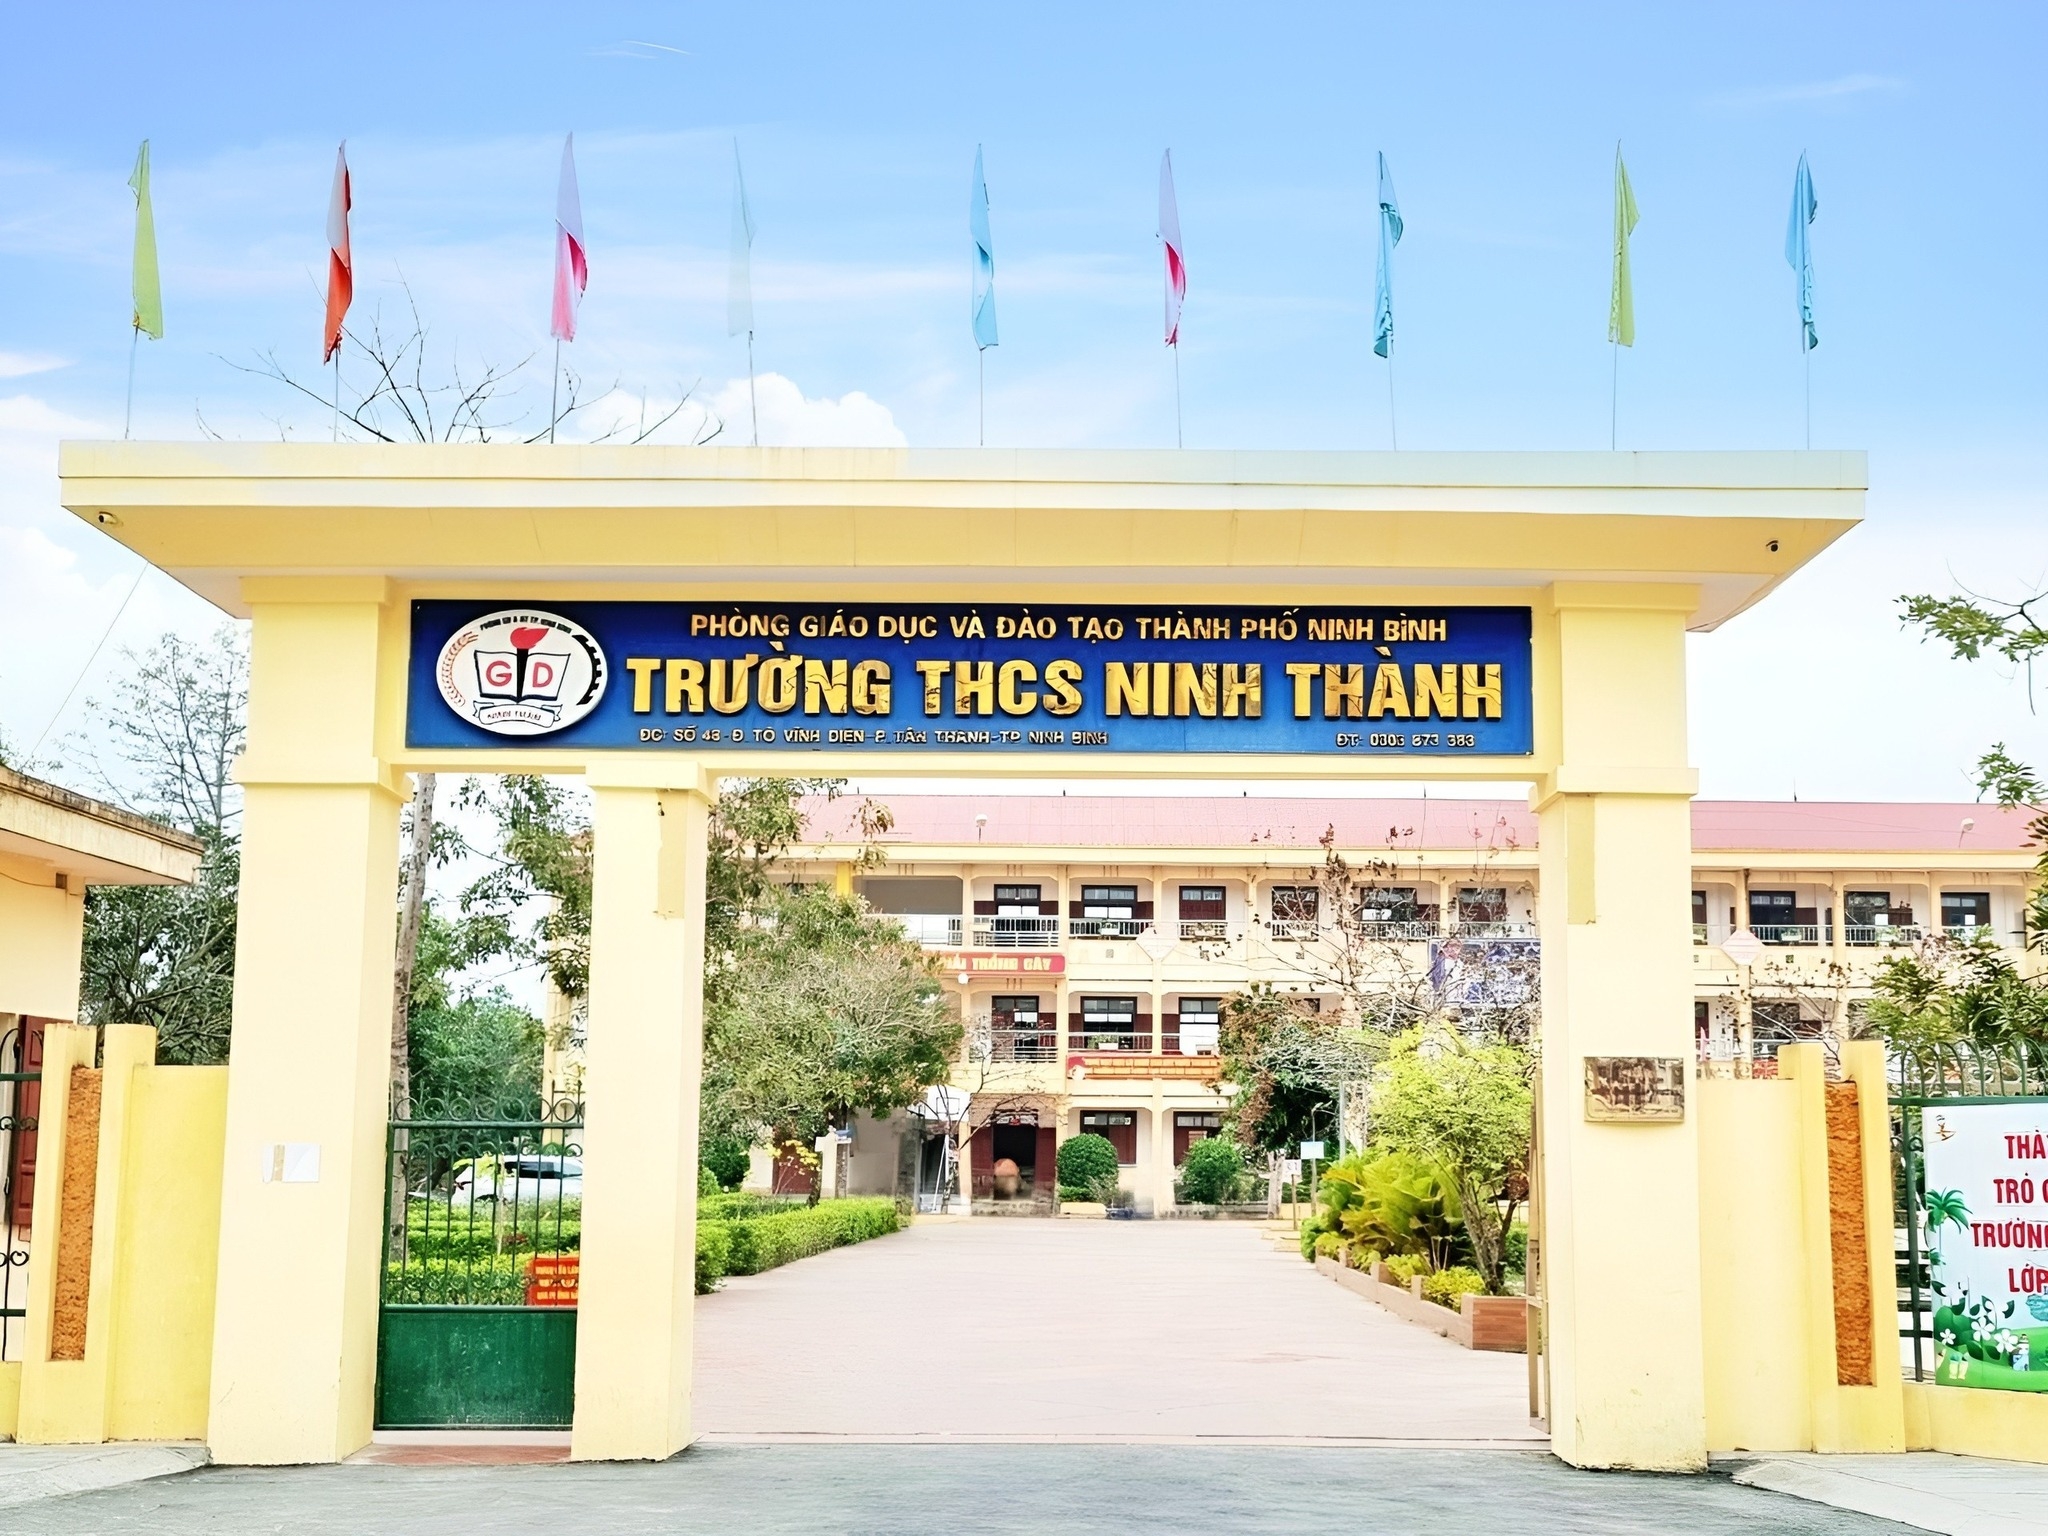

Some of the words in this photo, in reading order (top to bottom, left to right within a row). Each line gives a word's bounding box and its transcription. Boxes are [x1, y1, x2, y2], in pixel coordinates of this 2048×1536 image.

[691, 608, 790, 637] PHÒNG
[800, 609, 869, 638] GIÁO
[878, 615, 938, 644] DỤC
[950, 609, 986, 638] VÀ
[996, 608, 1057, 639] ĐÀO
[1067, 616, 1124, 645] TẠO
[1136, 610, 1231, 639] THÀNH
[1240, 607, 1299, 641] PHỐ
[1308, 618, 1373, 641] NINH
[1384, 613, 1446, 641] BÌNH
[626, 641, 891, 714] TRƯỜNG
[916, 659, 1083, 716] THCS
[1105, 661, 1262, 717] NINH
[1286, 646, 1502, 718] THÀNH
[673, 725, 699, 742] SỐ
[1028, 730, 1065, 744] NINH
[1993, 1173, 2034, 1204] TRÒ
